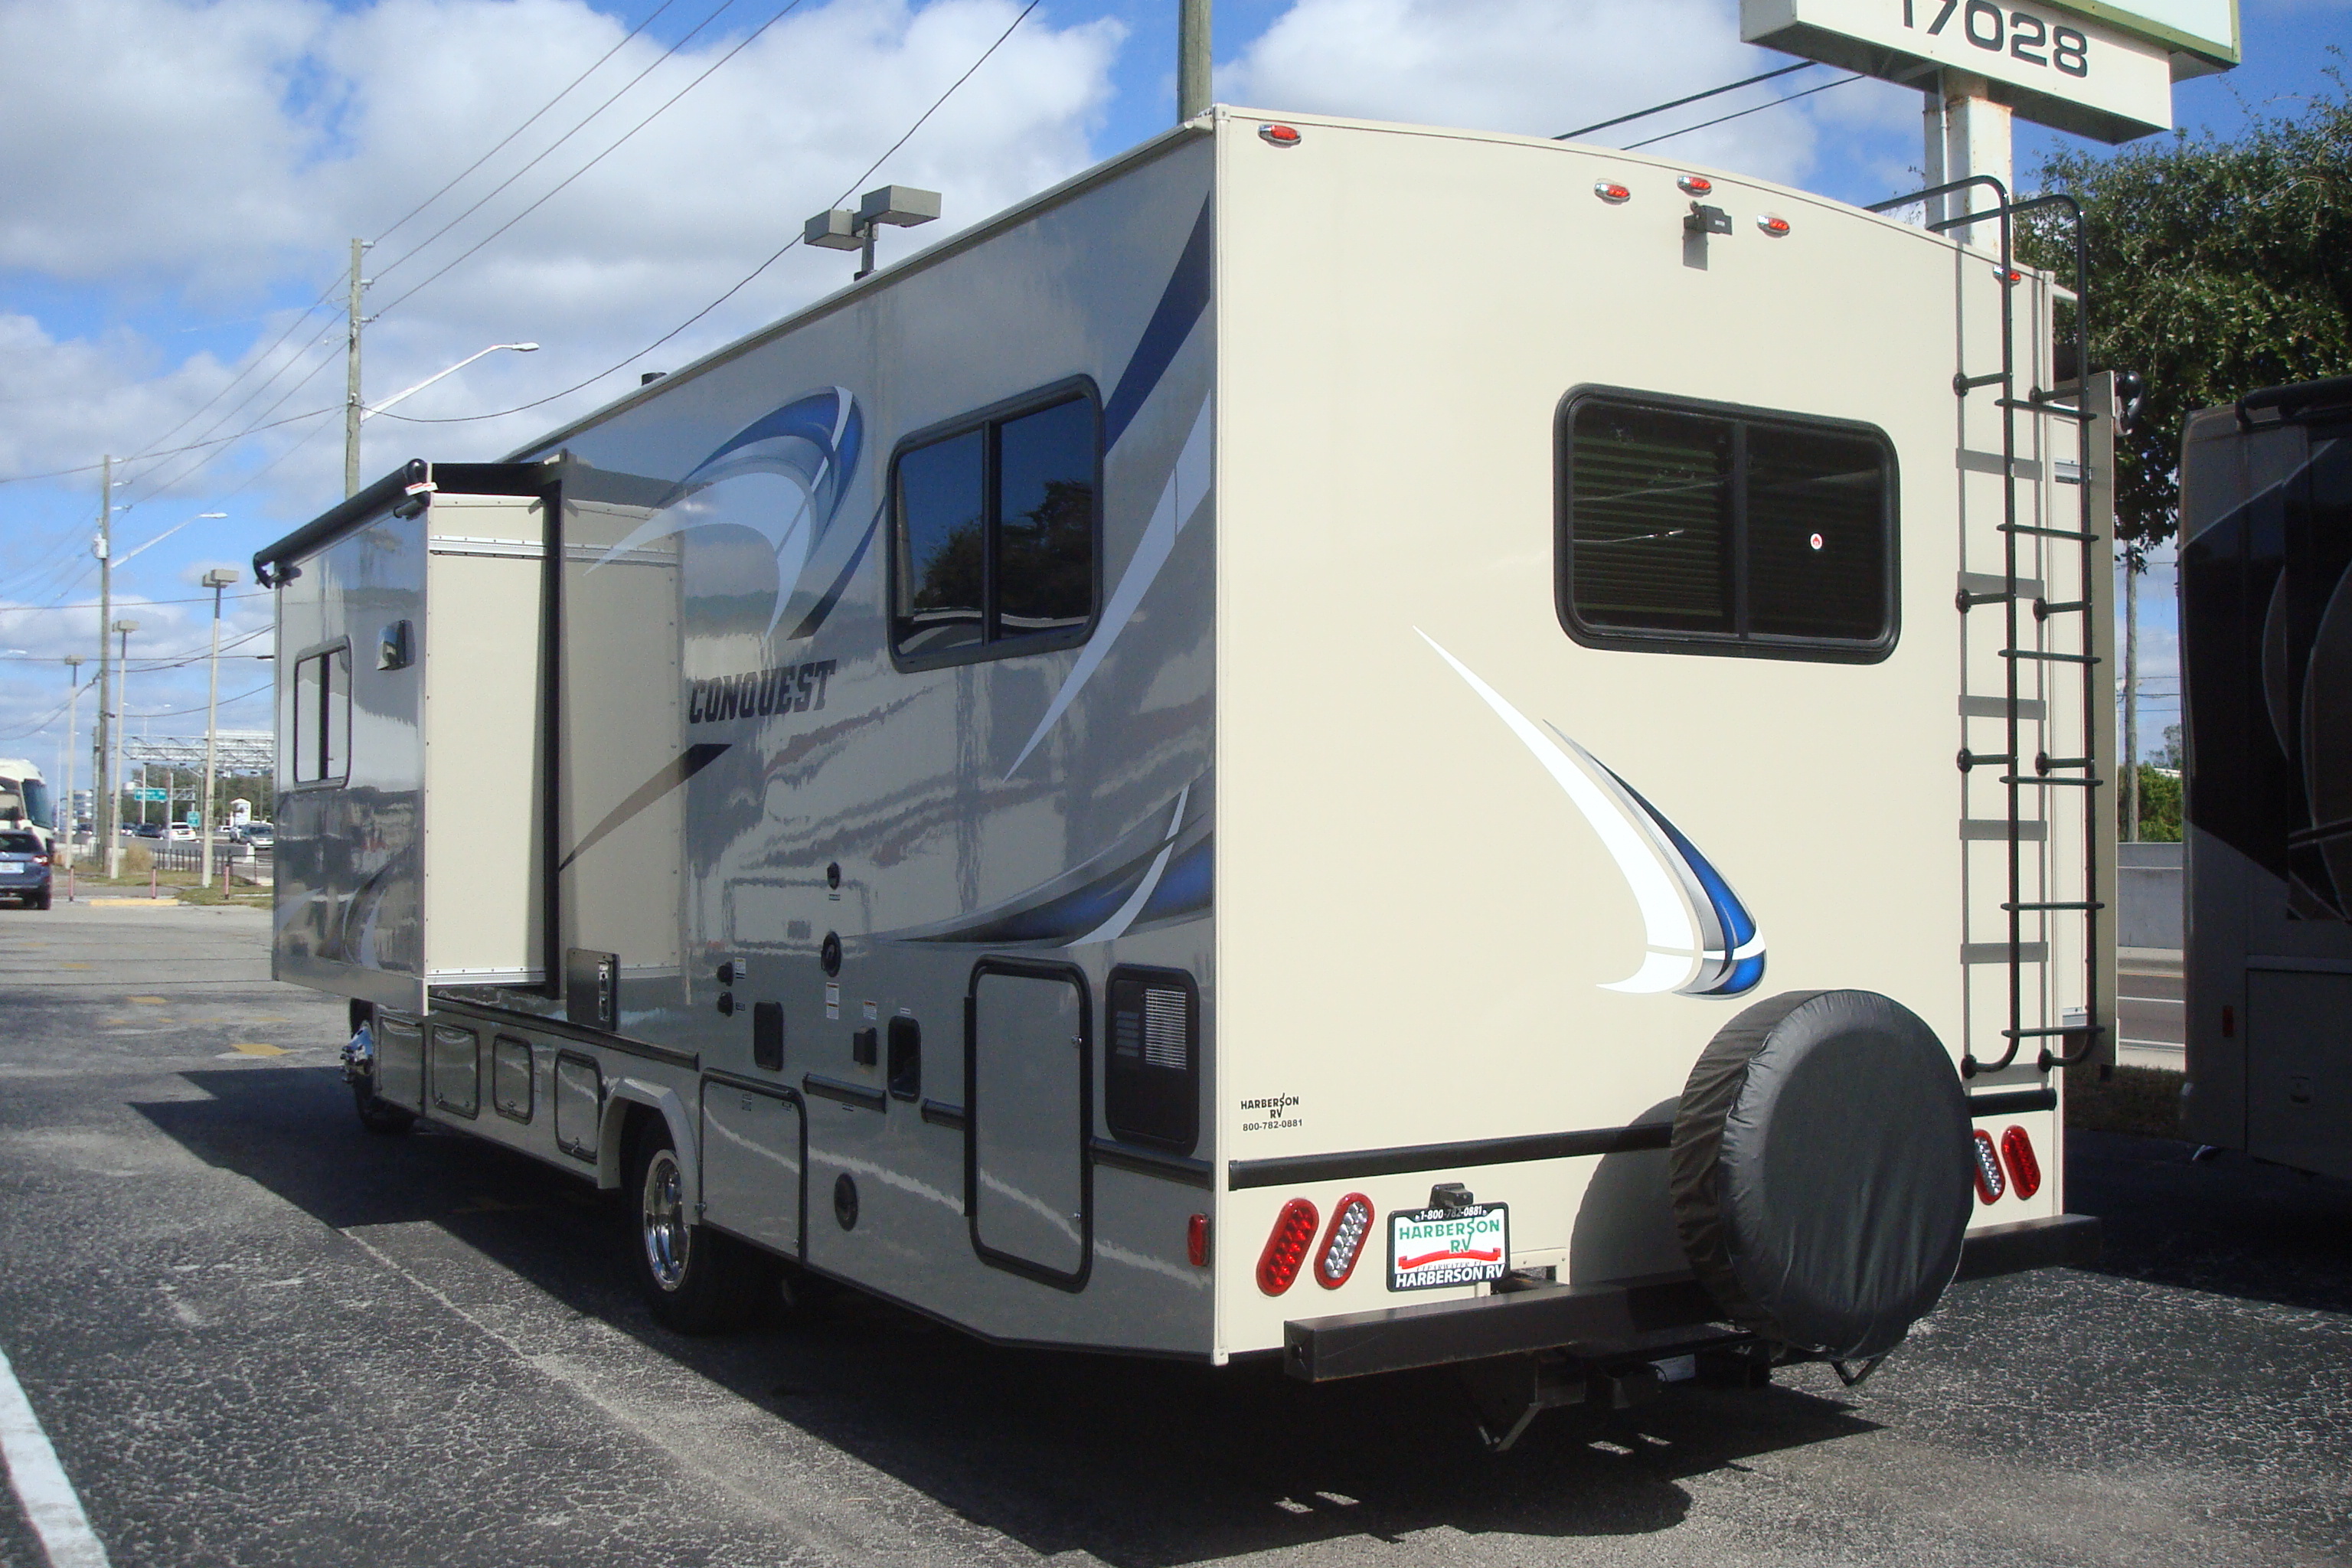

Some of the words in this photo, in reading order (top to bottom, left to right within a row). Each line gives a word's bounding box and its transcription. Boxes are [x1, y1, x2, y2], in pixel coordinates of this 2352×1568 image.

[1903, 0, 2088, 78] 17028
[689, 659, 837, 724] CONQUEST
[1240, 1093, 1299, 1110] HARBERSON
[1270, 1108, 1282, 1119] RV
[1243, 1119, 1302, 1132] 800-782-0881
[1420, 1205, 1482, 1220] 1-800-782-0881
[1399, 1217, 1500, 1240] HARBERSON
[1450, 1233, 1472, 1253] RV
[1395, 1266, 1483, 1288] HARBERSON
[1485, 1263, 1505, 1279] RV
